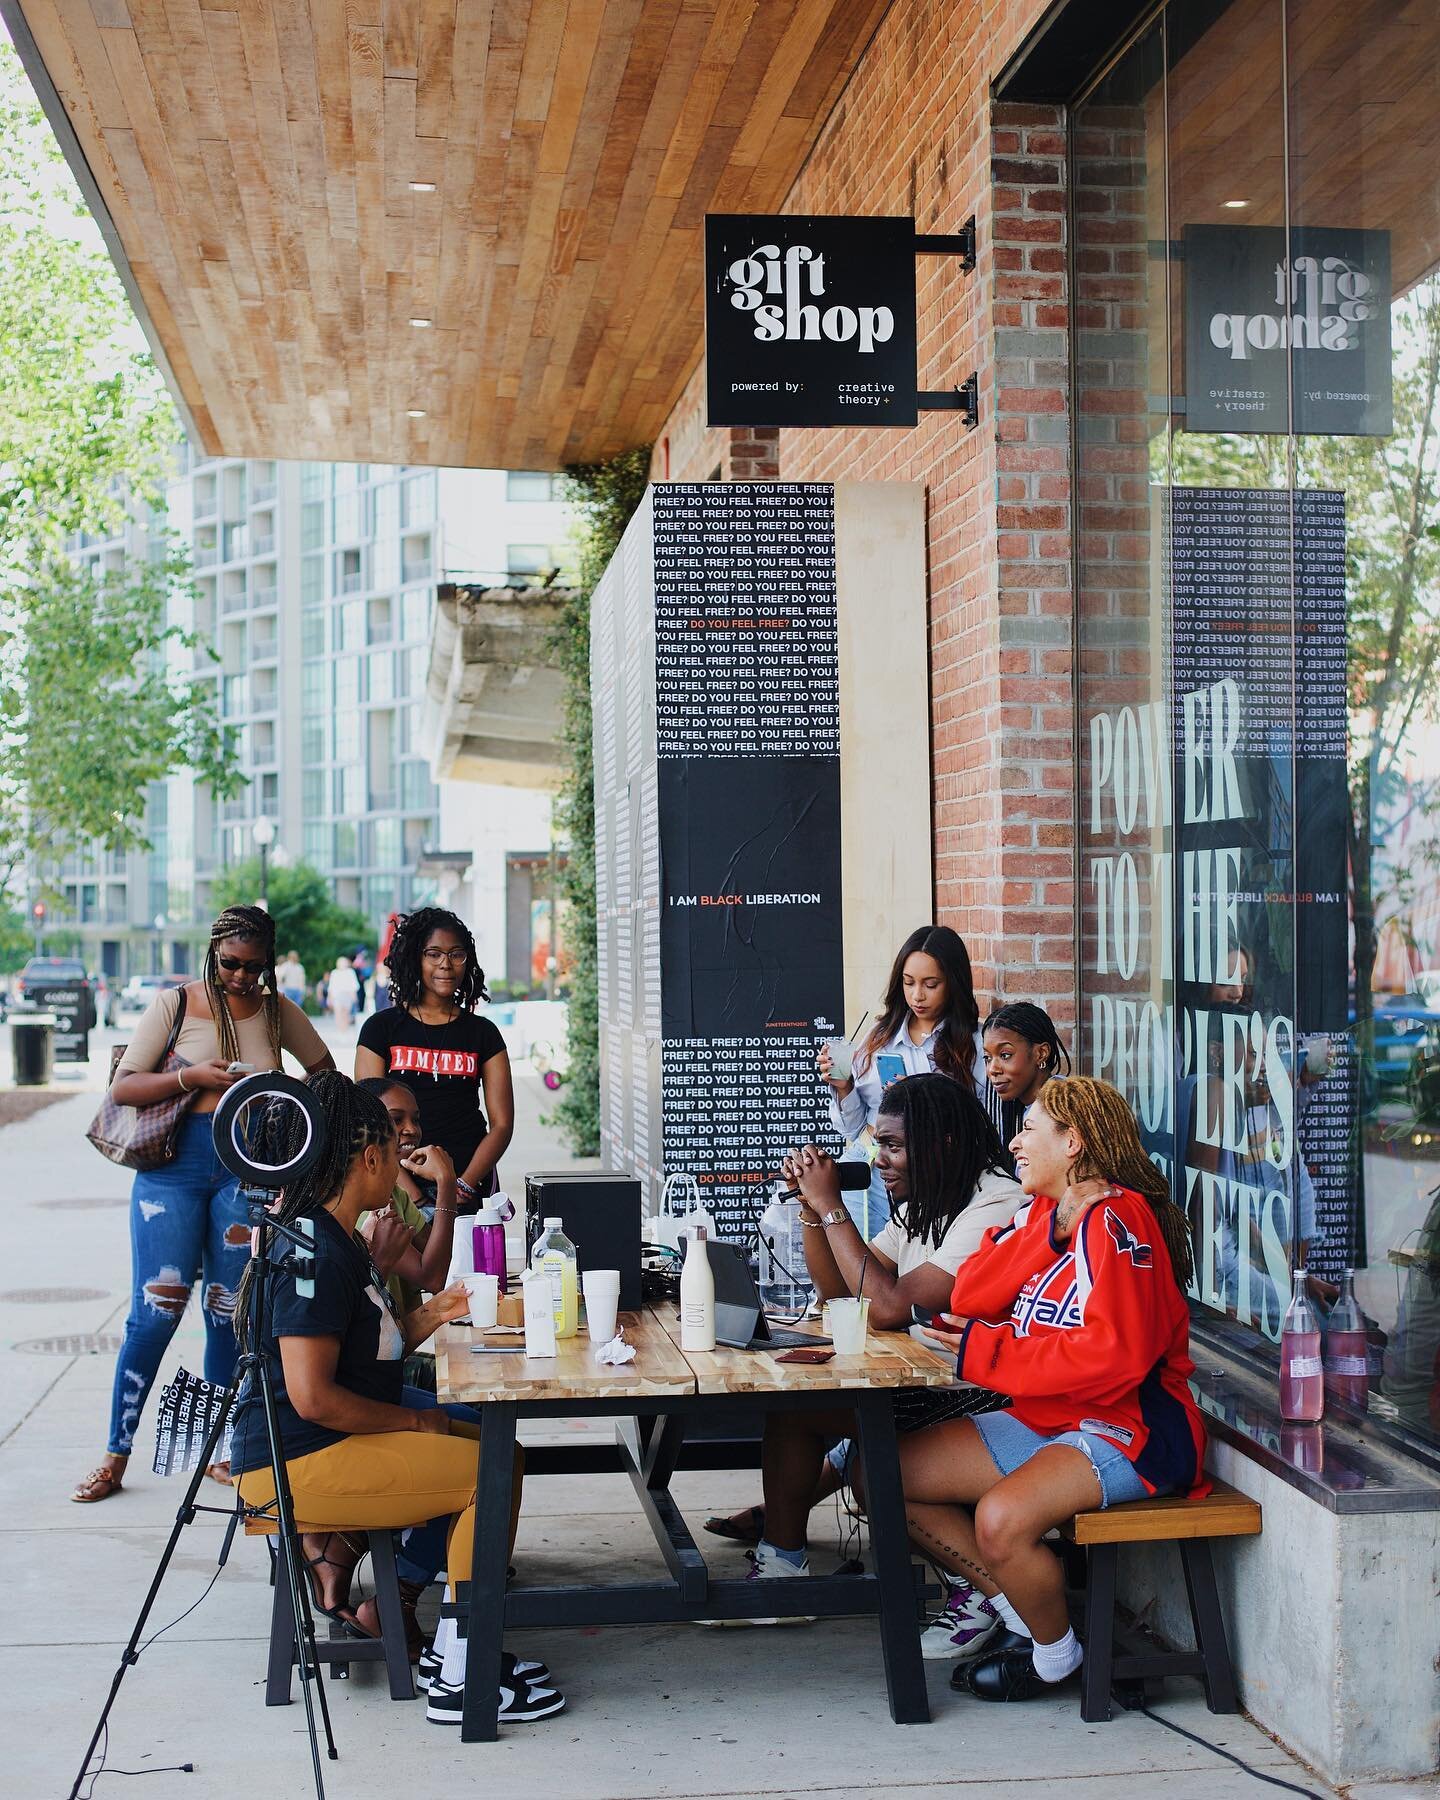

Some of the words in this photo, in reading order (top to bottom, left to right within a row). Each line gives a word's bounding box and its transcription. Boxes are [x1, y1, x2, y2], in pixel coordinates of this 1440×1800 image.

[728, 244, 826, 310] gift
[754, 304, 894, 352] shop
[731, 382, 779, 393] powered
[785, 382, 804, 393] by:
[838, 382, 895, 392] creative
[653, 486, 672, 494] YOU
[675, 485, 700, 494] FEEL
[702, 485, 733, 494] FREE?
[735, 485, 751, 493] DO
[752, 485, 774, 493] YOU
[777, 485, 801, 493] FEEL
[654, 498, 685, 506] FREE?
[687, 497, 703, 506] DO
[704, 497, 726, 506] YOU
[729, 497, 754, 506] FEEL
[756, 497, 787, 505] FREE?
[789, 497, 804, 505] DO
[806, 497, 828, 506] YOU
[653, 510, 673, 518] YOU
[676, 510, 700, 518] FEEL
[702, 509, 734, 518] FREE?
[736, 509, 751, 518] DO
[753, 509, 775, 518] YOU
[777, 509, 802, 518] FEEL
[655, 522, 686, 531] FREE?
[688, 522, 703, 530] DO
[705, 522, 727, 530] YOU
[729, 522, 754, 530] FEEL
[756, 521, 788, 530] FREE?
[790, 521, 805, 530] DO
[806, 522, 828, 530] YOU
[654, 534, 674, 543] YOU
[676, 534, 701, 543] FEEL
[703, 534, 734, 542] FREE?
[736, 534, 752, 542] DO
[753, 534, 775, 542] YOU
[778, 534, 803, 542] FEEL
[655, 546, 686, 555] FREE?
[688, 546, 704, 555] DO
[706, 546, 728, 555] YOU
[730, 546, 755, 554] FEEL
[757, 546, 788, 554] FREE?
[790, 546, 805, 554] DO
[807, 546, 829, 554] YOU
[655, 608, 676, 616] YOU
[678, 608, 703, 616] FEEL
[705, 607, 736, 616] FREE?
[738, 607, 754, 616] DO
[755, 607, 777, 616] YOU
[780, 607, 804, 615] FEEL
[656, 620, 688, 628] FREE?
[690, 620, 706, 628] DO
[708, 620, 729, 628] YOU
[732, 620, 756, 628] FEEL
[759, 619, 790, 628] FREE?
[792, 619, 807, 628] DO
[809, 619, 831, 627] YOU
[1090, 678, 1244, 834] POWER
[670, 896, 674, 906] I
[676, 896, 697, 906] AM
[700, 895, 743, 905] BLACK
[746, 894, 820, 904] LIBERATION
[1091, 852, 1140, 981] TO
[1152, 847, 1242, 985] THE
[661, 1039, 682, 1048] YOU
[684, 1038, 710, 1047] FEEL
[712, 1038, 743, 1047] FREE?
[745, 1038, 761, 1046] DO
[762, 1037, 784, 1046] YOU
[787, 1037, 812, 1046] FEEL
[663, 1051, 695, 1060] FREE?
[697, 1050, 712, 1060] DO
[714, 1050, 736, 1059] YOU
[738, 1050, 764, 1059] FEEL
[766, 1049, 797, 1058] FREE?
[799, 1049, 815, 1058] DO
[394, 1049, 475, 1073] LIMITED
[662, 1088, 683, 1097] YOU
[686, 1088, 711, 1097] FEEL
[712, 1087, 744, 1096] FREE?
[746, 1087, 762, 1096] DO
[763, 1086, 785, 1095] YOU
[788, 1086, 813, 1095] FEEL
[664, 1101, 696, 1110] FREE?
[698, 1100, 713, 1109] DO
[715, 1100, 737, 1109] YOU
[739, 1099, 765, 1108] FEEL
[766, 1098, 798, 1108] FREE?
[800, 1098, 816, 1107] DO
[663, 1138, 684, 1147] YOU
[686, 1138, 712, 1146] FEEL
[713, 1137, 745, 1146] FREE?
[747, 1136, 762, 1145] DO
[764, 1136, 786, 1144] YOU
[788, 1135, 814, 1144] FEEL
[700, 1175, 714, 1183] DO
[717, 1174, 738, 1182] YOU
[741, 1174, 766, 1182] FEEL
